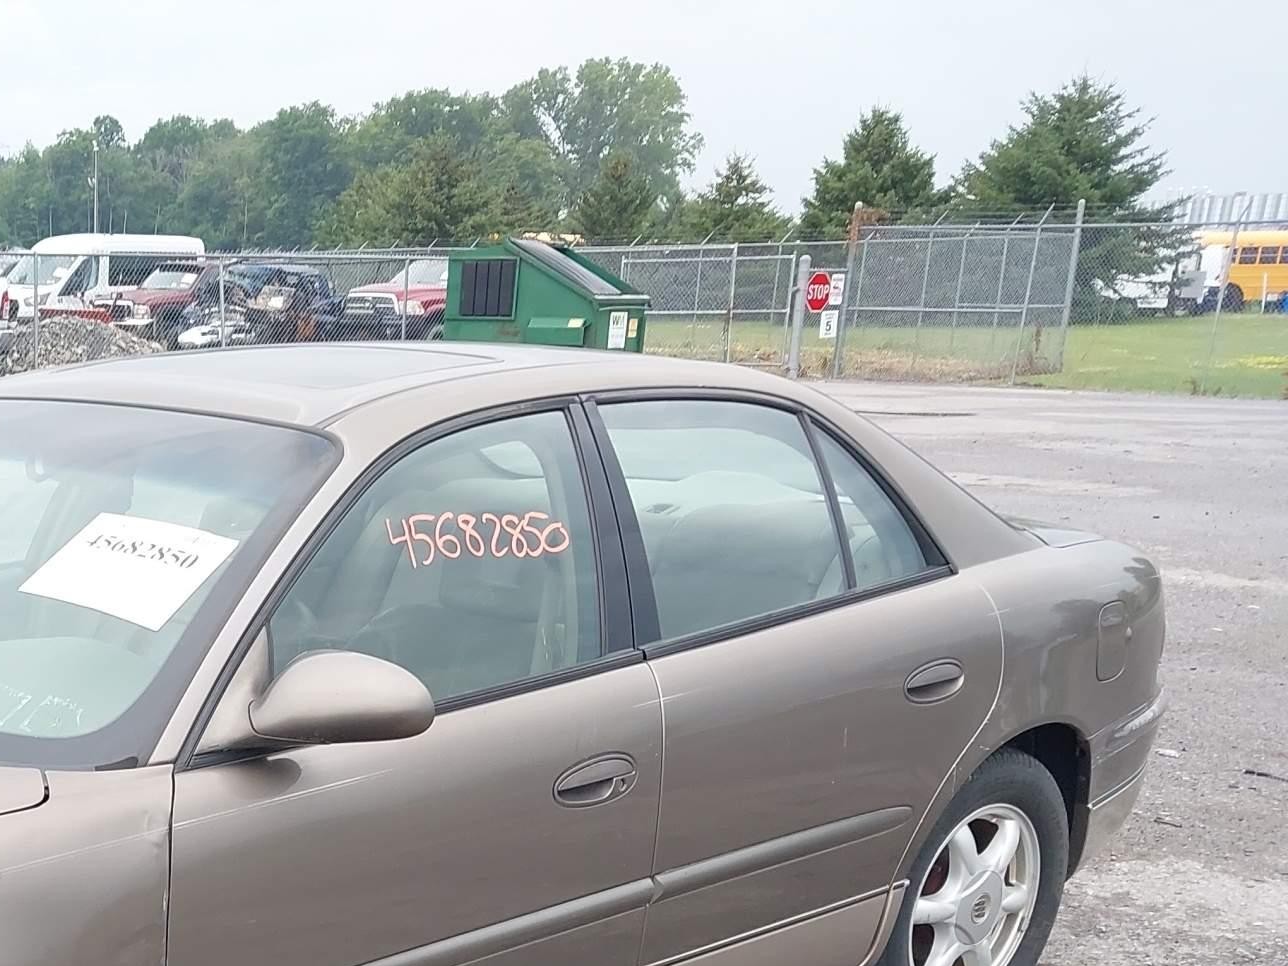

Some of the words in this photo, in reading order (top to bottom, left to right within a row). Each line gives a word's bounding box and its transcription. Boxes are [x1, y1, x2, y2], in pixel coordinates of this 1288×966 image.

[807, 284, 830, 300] STOP
[825, 320, 832, 332] 5
[87, 534, 199, 568] 45682850
[384, 511, 570, 569] 45682850
